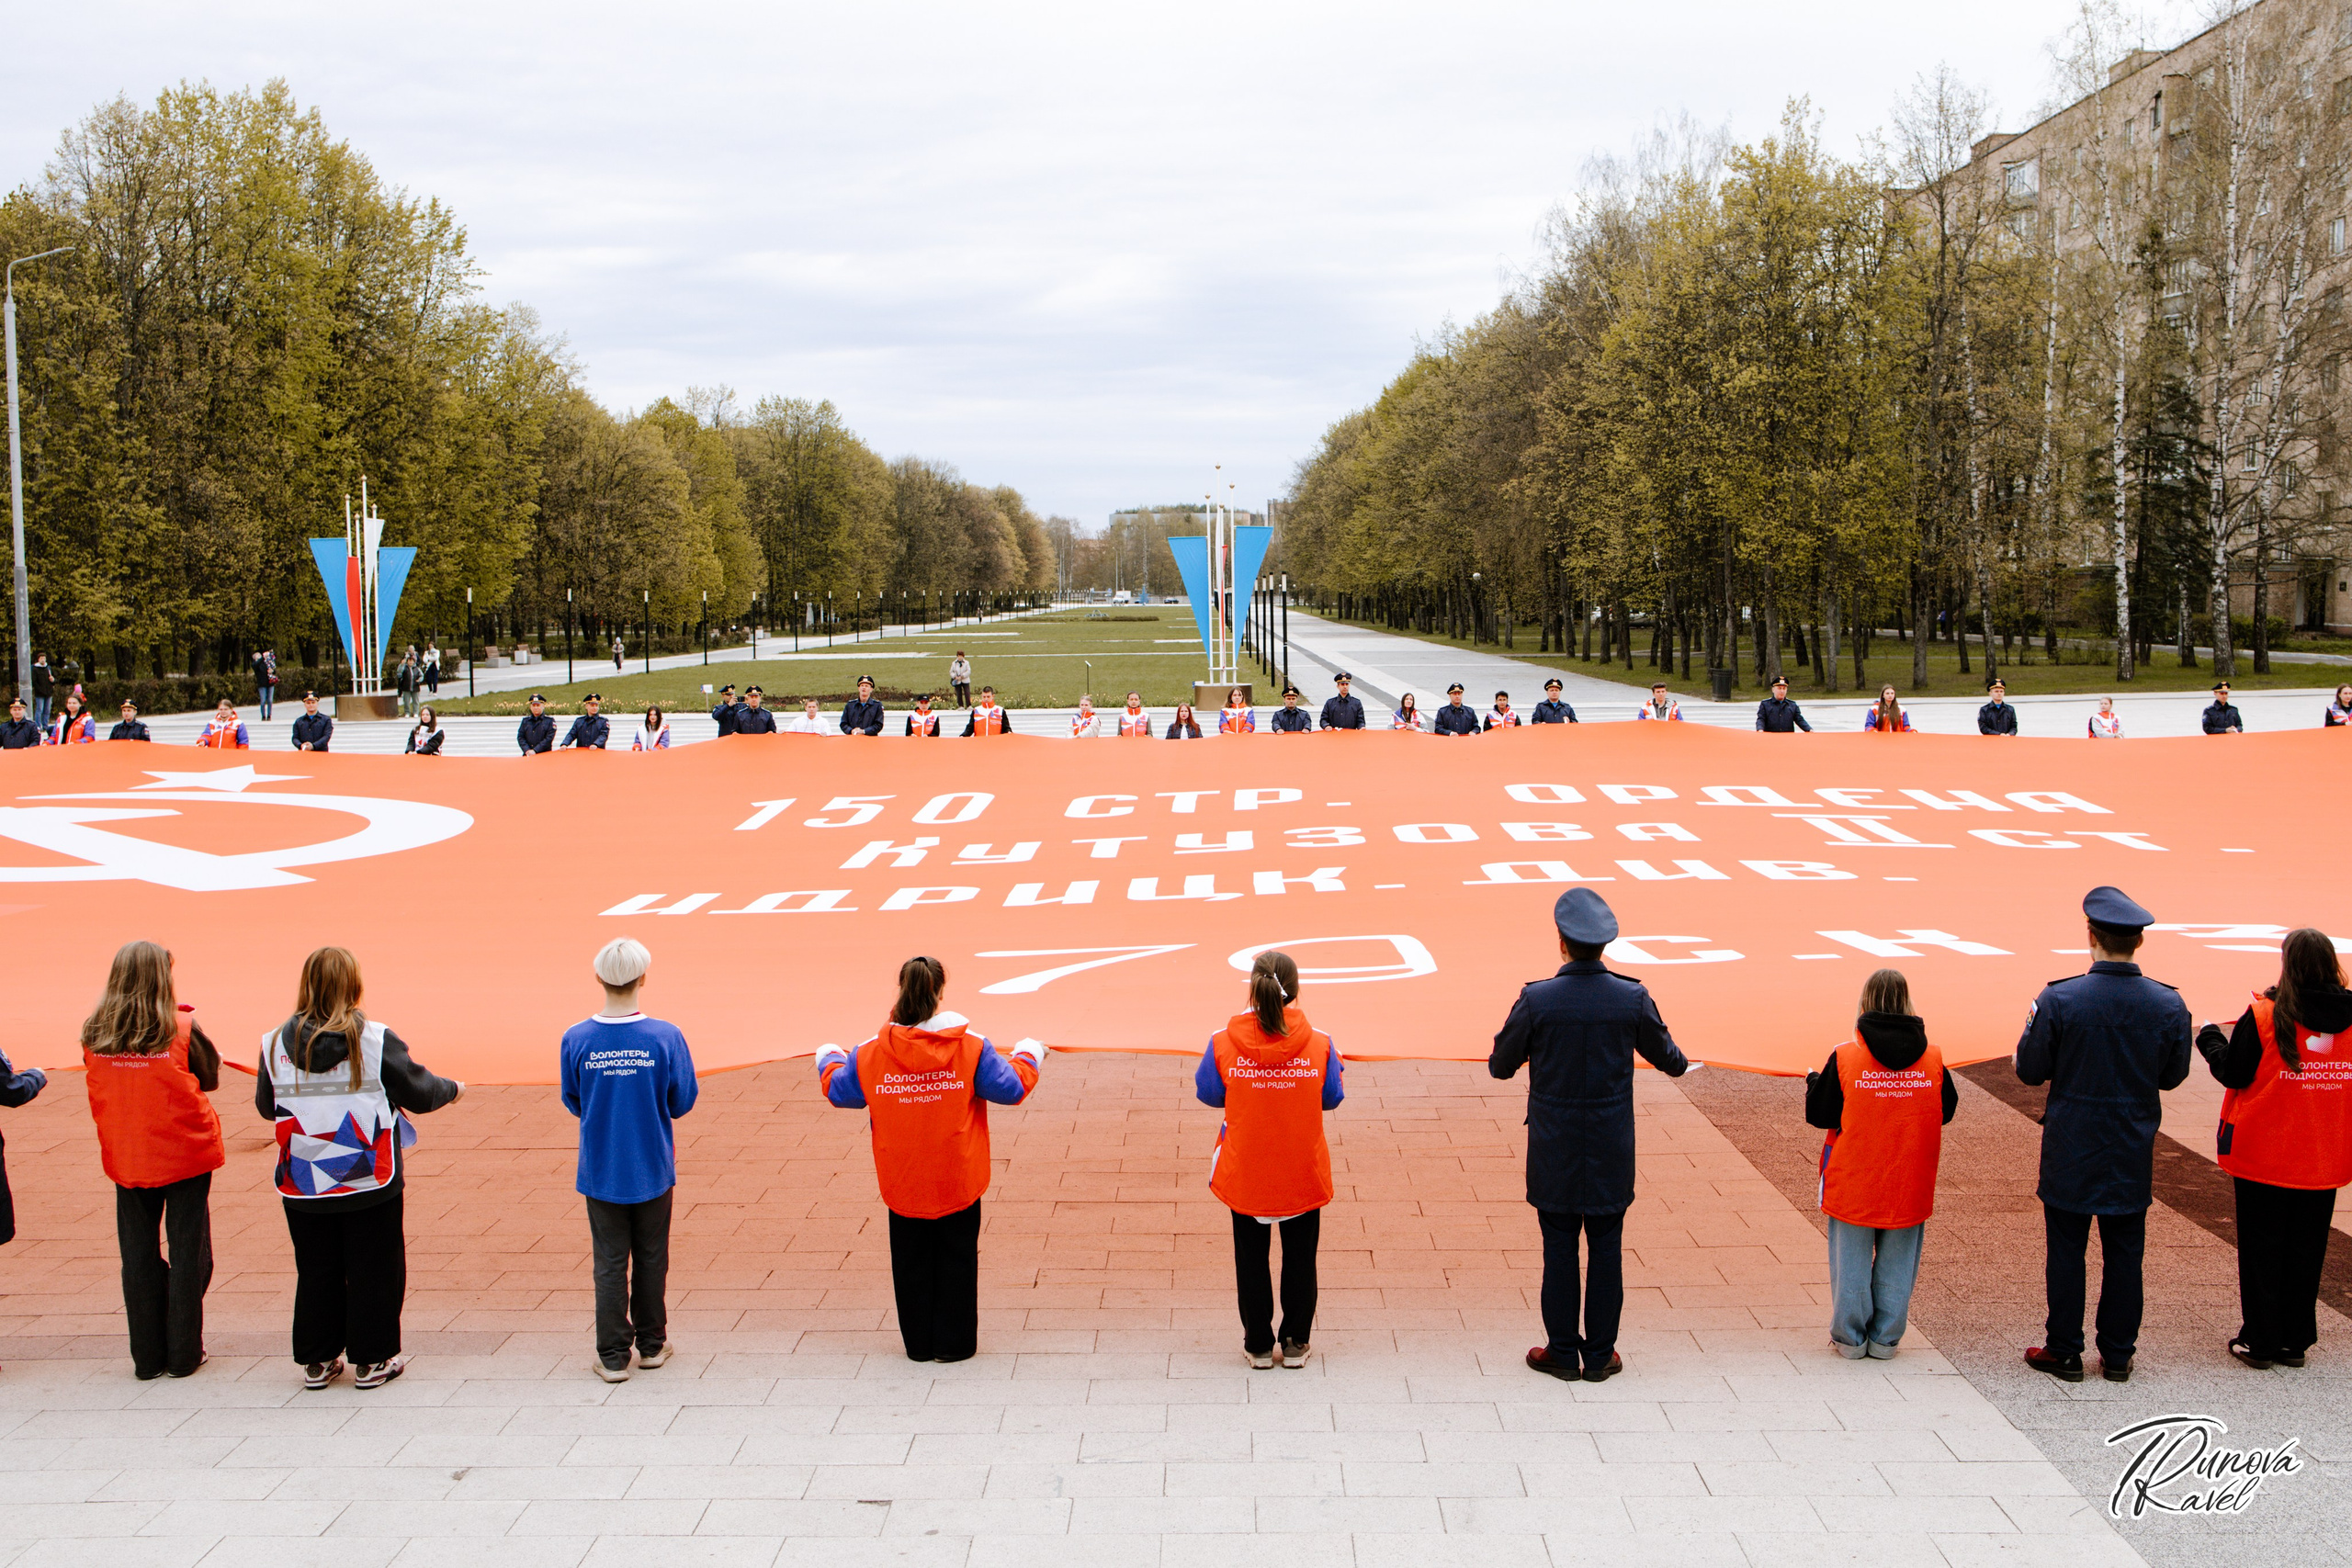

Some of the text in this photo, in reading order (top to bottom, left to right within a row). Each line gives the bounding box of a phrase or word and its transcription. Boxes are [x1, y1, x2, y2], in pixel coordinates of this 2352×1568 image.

[734, 784, 2114, 830] 150 СТР. ОРДЕНА
[839, 822, 1702, 869] КУТУЗОВА
[1967, 829, 2255, 852] СТ.
[598, 860, 1918, 916] ИДРИЦК. ДИВ.
[974, 934, 1438, 995] 79
[590, 1050, 650, 1061] ВОЛОНТЕРЫ
[1237, 1056, 1310, 1066] ВОЕРЫ
[585, 1059, 655, 1069] ПОДМОСКОВЬЯ
[2298, 1061, 2352, 1070] ОЛОНТЕР
[884, 1070, 956, 1083] ВОЛОНТЕРЫ
[1228, 1067, 1318, 1078] ПОДМОСКОВЬЯ
[1861, 1070, 1926, 1079] ВОЛОНТЕРЫ
[876, 1081, 964, 1094] ПОДМОСКОВЬЯ
[1267, 1081, 1295, 1089] РЯДОМ
[1855, 1079, 1932, 1089] ПОДМОСКОВЬЯ
[914, 1094, 942, 1103] РЯДОМ
